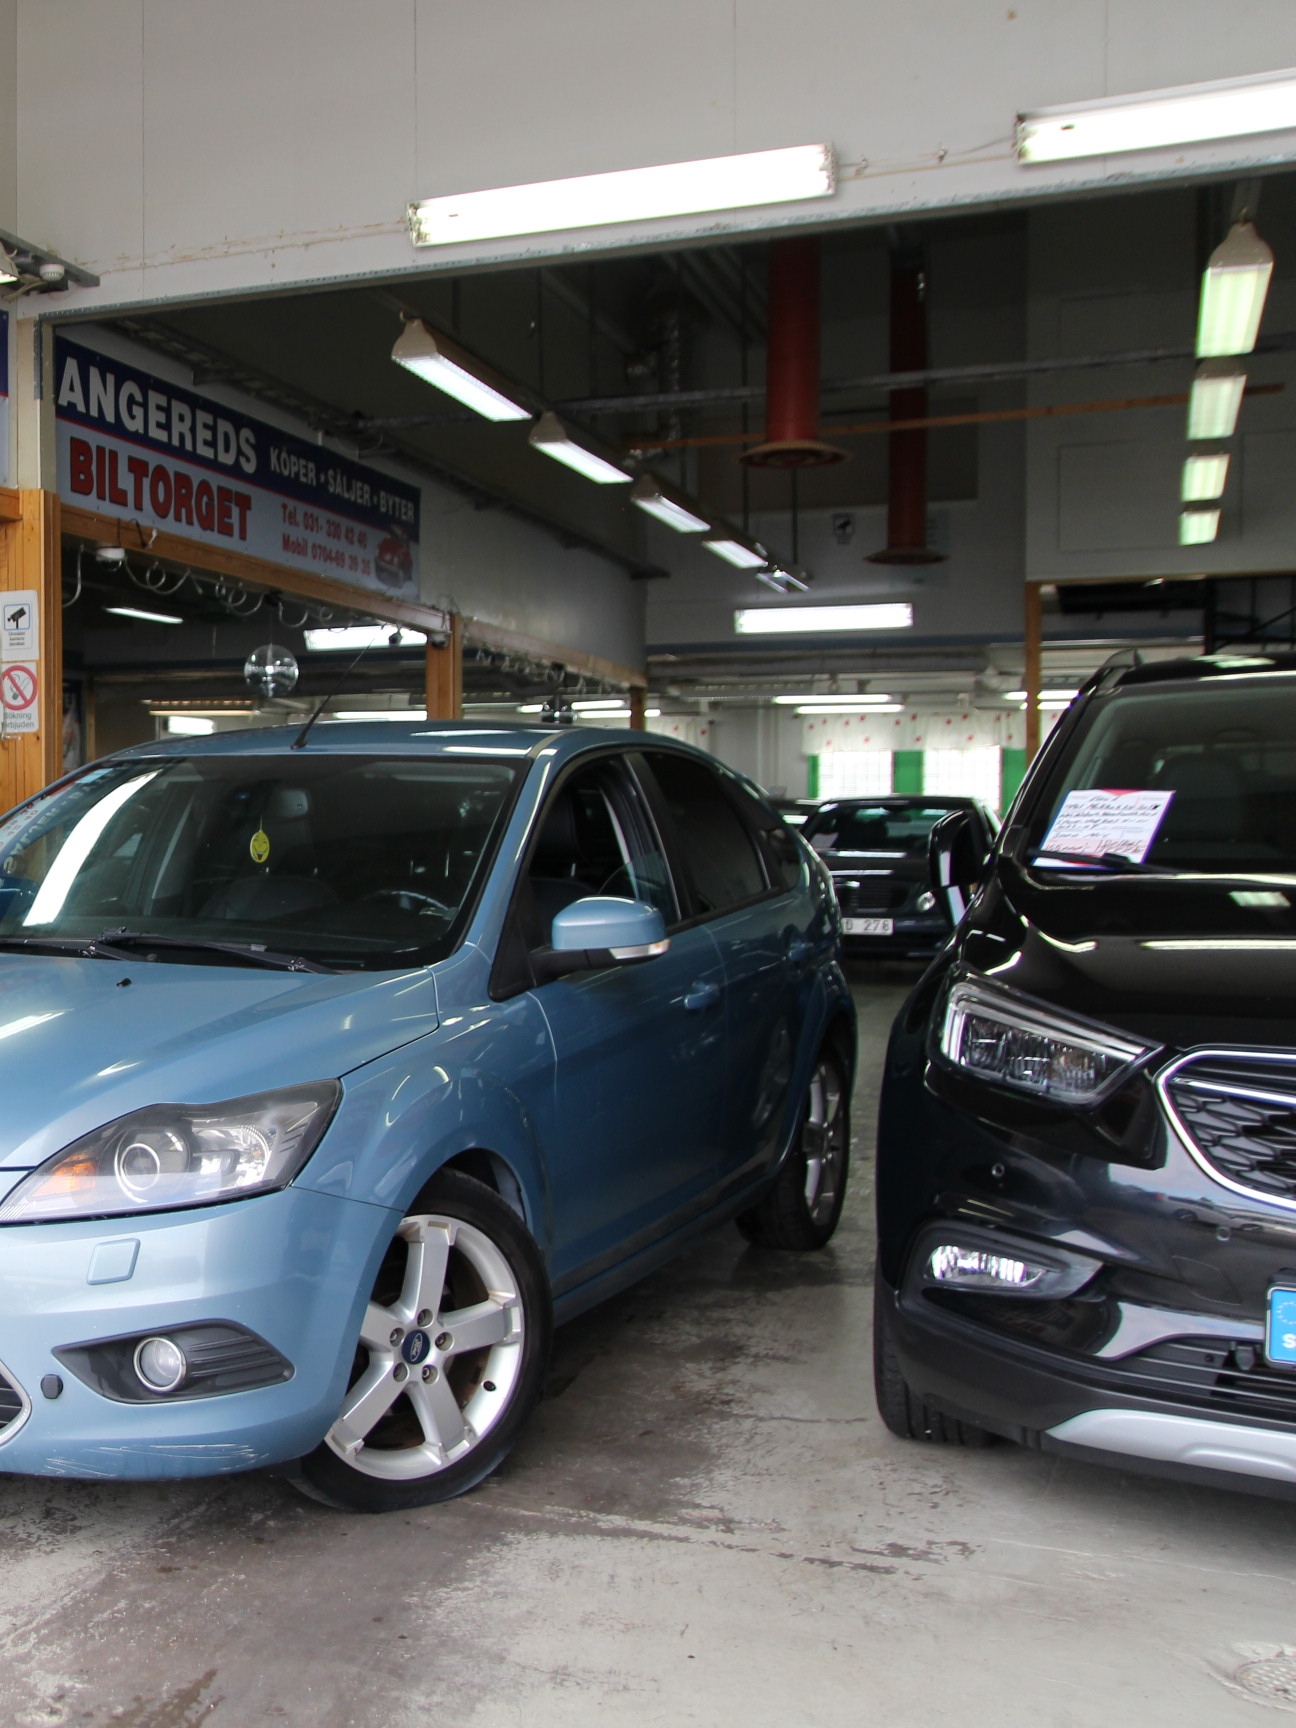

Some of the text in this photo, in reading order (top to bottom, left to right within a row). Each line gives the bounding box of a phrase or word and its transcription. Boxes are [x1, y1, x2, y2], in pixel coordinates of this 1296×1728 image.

[57, 356, 258, 475] ANGEREDS
[69, 436, 252, 542] BILTORGET
[269, 446, 415, 524] KÖPER SÄLJER BYTER
[281, 503, 300, 527] Tel.
[282, 534, 308, 558] Mobil
[2, 720, 35, 730] rbjuden
[1282, 1333, 1296, 1349] S
